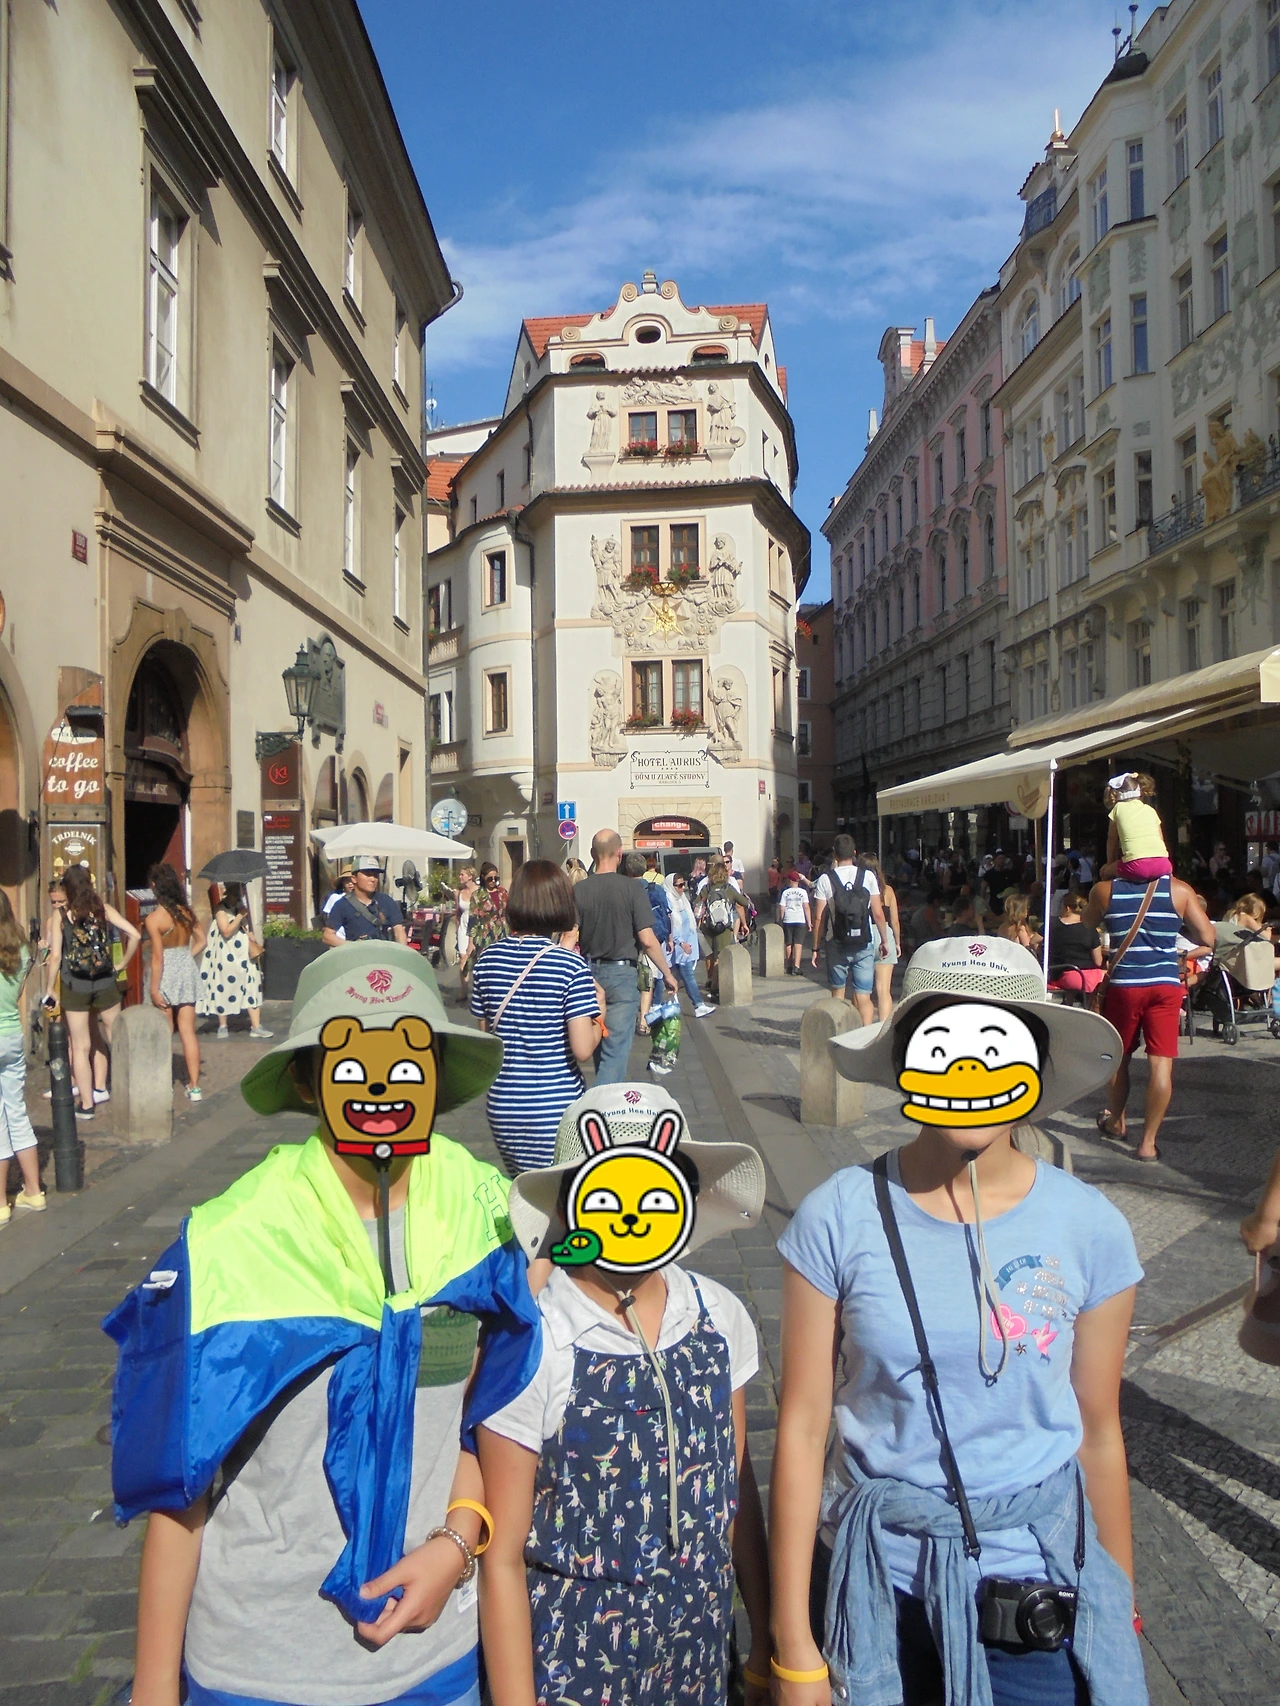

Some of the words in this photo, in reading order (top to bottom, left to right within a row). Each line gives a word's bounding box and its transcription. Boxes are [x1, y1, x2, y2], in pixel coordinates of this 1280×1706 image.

[49, 752, 99, 773] coffee
[638, 758, 667, 766] HOTEL
[670, 758, 701, 766] AURUS
[657, 772, 678, 780] ZLATÉ
[47, 775, 69, 793] to
[74, 779, 100, 799] go
[52, 831, 97, 846] TRDELNÍK
[941, 960, 967, 968] Kyung
